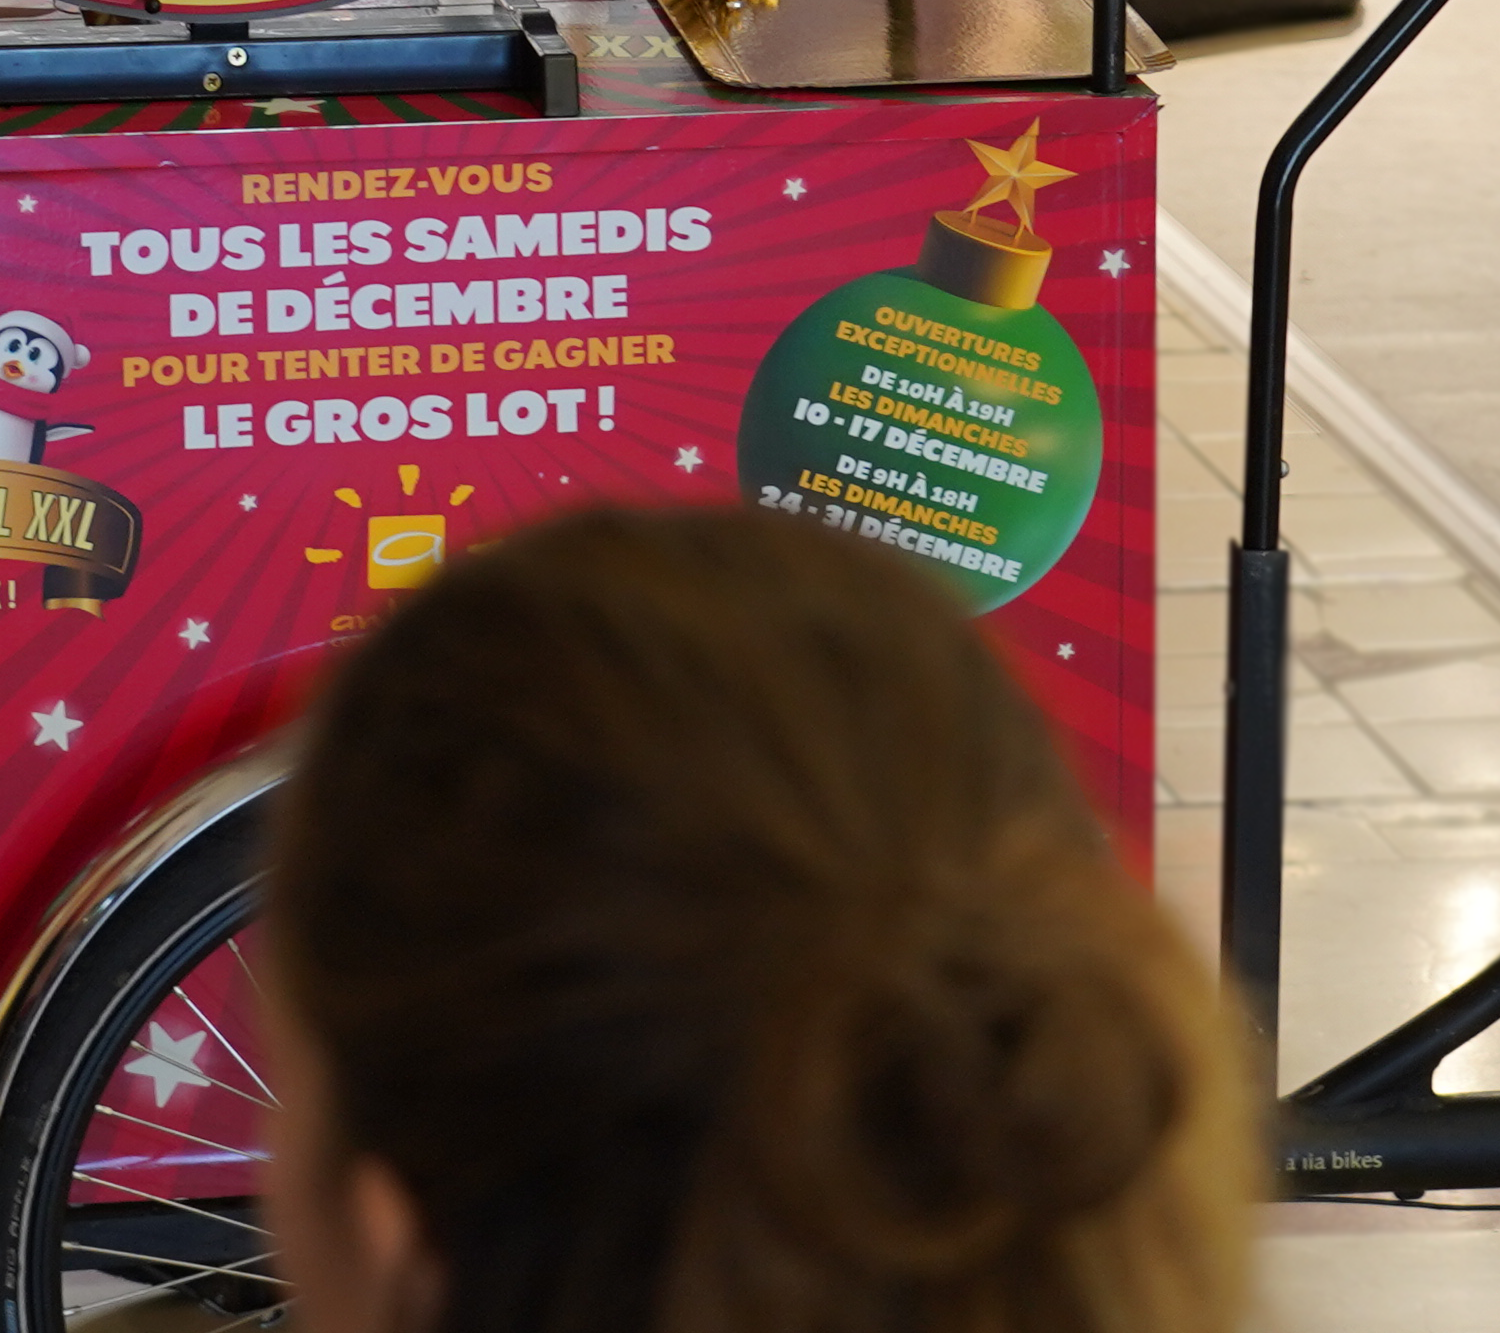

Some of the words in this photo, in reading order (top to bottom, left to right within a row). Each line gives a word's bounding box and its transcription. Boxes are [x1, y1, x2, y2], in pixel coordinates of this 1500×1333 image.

[241, 163, 552, 204] RENDEZ-VOUS
[81, 226, 264, 277] TOUS
[279, 220, 392, 268] LES
[404, 207, 713, 263] SAMEDIS
[170, 291, 253, 337] DE
[267, 271, 628, 333] DÉCEMBRE
[123, 353, 248, 387] POUR
[258, 344, 421, 381] TENTER
[431, 343, 486, 374] DE
[494, 334, 675, 370] GAGNER
[835, 321, 1063, 405] EXCEPTIONNELLES
[875, 306, 1041, 372] OUVERTURES
[184, 404, 254, 449] LE
[265, 394, 453, 446] GROS
[465, 388, 586, 437] LOT
[598, 385, 614, 431] !
[830, 382, 873, 414] LES
[877, 393, 1028, 458] DIMANCHES
[861, 364, 893, 389] DE
[896, 375, 941, 406] 10H
[945, 381, 965, 410] À
[967, 399, 1014, 428] 19H
[794, 398, 829, 426] 10
[849, 414, 883, 442] 17
[884, 428, 1048, 495] DÉCEMBRE
[798, 470, 842, 498] LES
[845, 480, 999, 545] DIMANCHES
[836, 455, 870, 480] DE
[872, 467, 906, 493] 9H
[909, 473, 929, 499] À
[932, 487, 978, 513] 18H
[25, 491, 96, 552] XXL
[758, 485, 803, 515] 24
[822, 503, 855, 532] 31
[858, 519, 1023, 584] DÉCEMBRE
[7, 580, 17, 609] !
[1332, 1150, 1383, 1169] bikes
